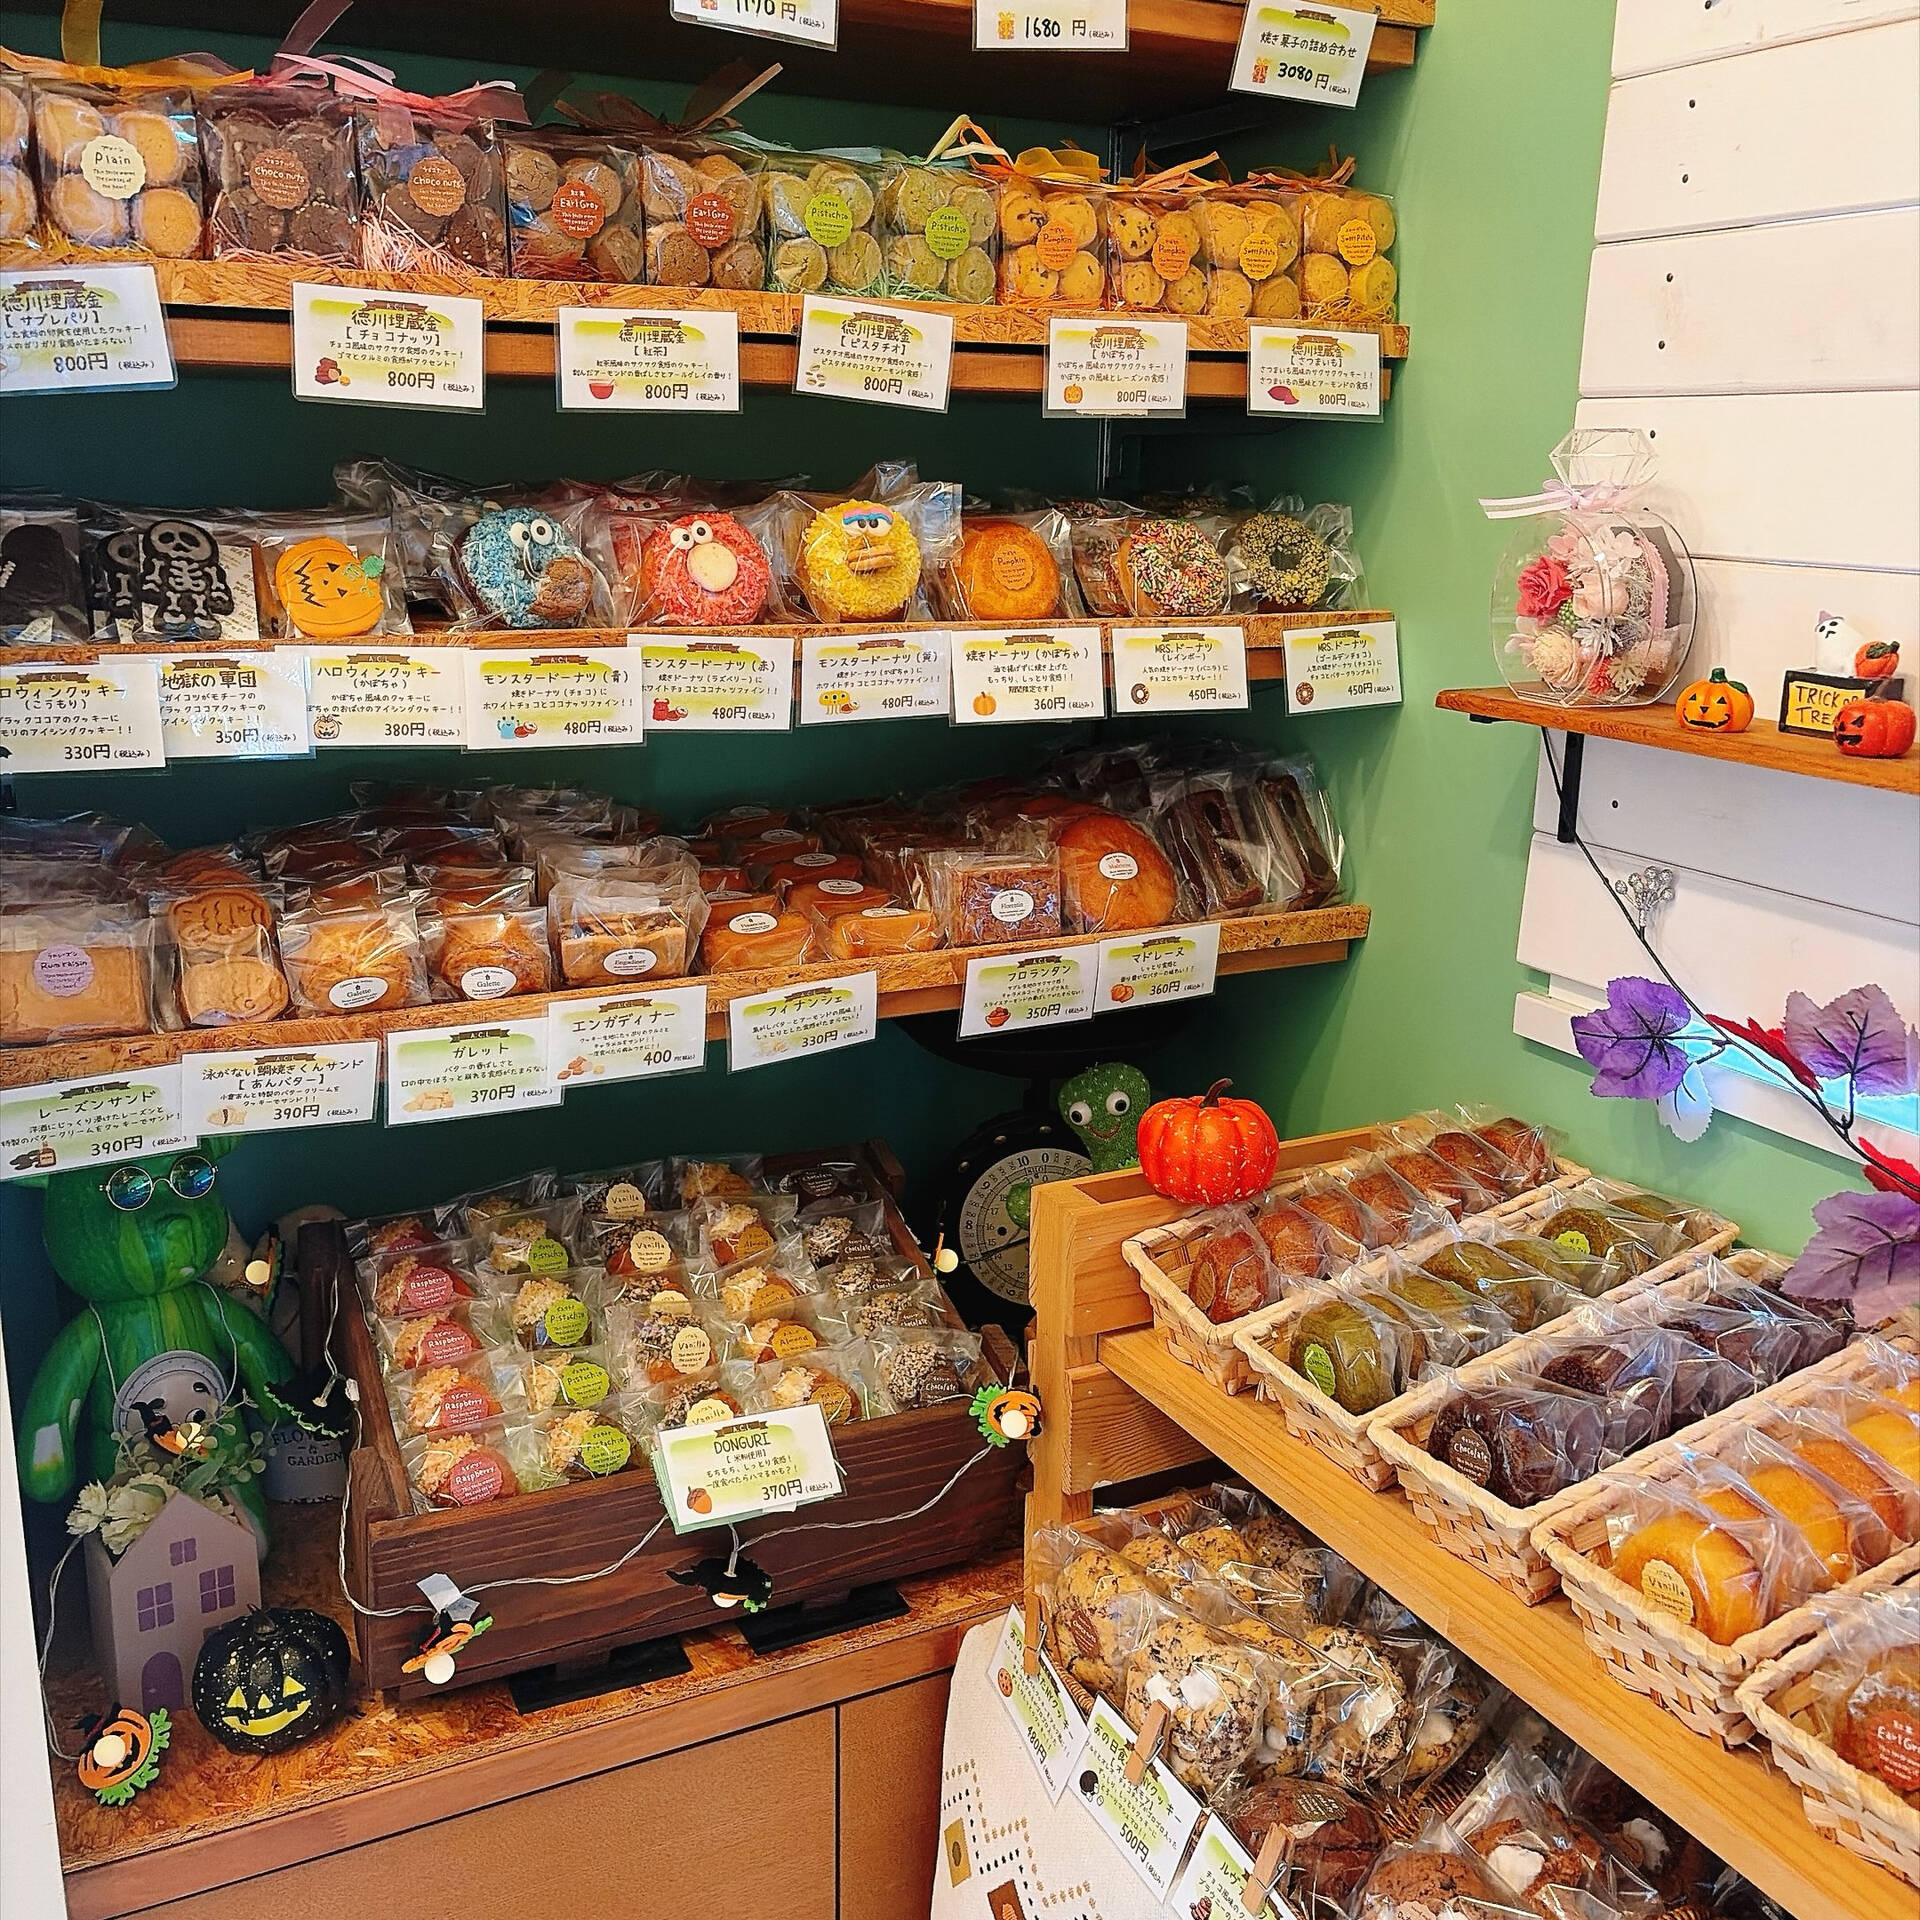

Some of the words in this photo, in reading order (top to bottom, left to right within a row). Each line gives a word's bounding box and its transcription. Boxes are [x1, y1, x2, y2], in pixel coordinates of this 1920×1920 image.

[1025, 15, 1061, 39] 1680
[1260, 32, 1357, 58] 焼き菓子の詰め合わせ
[1278, 63, 1313, 82] 3080
[96, 152, 130, 164] Plain
[561, 198, 578, 207] Earl
[580, 200, 598, 210] Grey
[693, 208, 710, 218] Earl
[711, 210, 729, 220] Grey
[351, 310, 442, 332] 徳川埋蔵金
[619, 329, 687, 344] 徳川埋蔵金
[841, 320, 913, 343] 徳川埋蔵金
[1090, 337, 1147, 350] 徳川埋蔵金
[1292, 344, 1344, 357] 徳川埋蔵金
[53, 353, 108, 373] 800円
[388, 371, 435, 389] 800円
[864, 376, 902, 394] 800円
[645, 384, 688, 399] 800円
[1117, 390, 1146, 402] 800円
[1319, 393, 1346, 405] 800円
[317, 666, 441, 678] ハロウィンクッキー
[162, 671, 257, 690] 地獄の軍団
[1189, 688, 1217, 700] 450円
[1348, 683, 1372, 696] 450円
[1795, 685, 1840, 707] TRICK
[882, 695, 912, 709] 480円
[1034, 697, 1066, 710] 360円
[712, 707, 746, 720] 480円
[385, 722, 425, 736] 380円
[564, 721, 600, 734] 480円
[65, 744, 110, 759] 330円
[1132, 947, 1184, 963] マドレーヌ
[1008, 966, 1071, 982] フロランタン
[347, 989, 371, 998] Galette
[1150, 981, 1180, 995] 360円
[767, 995, 842, 1016] フィナンシェ
[1027, 1004, 1060, 1019] 350円
[573, 1011, 675, 1032] エンガディナー
[802, 1030, 838, 1048] 330円
[453, 1043, 509, 1059] ガレット
[644, 1050, 672, 1066] 400
[202, 1060, 364, 1080] 泳がない鯛焼きくんサンド
[471, 1085, 515, 1103] 370円
[39, 1090, 156, 1119] レーズンサンド
[274, 1105, 319, 1120] 390円
[91, 1135, 143, 1156] 390円
[612, 1195, 639, 1203] Vanilla
[411, 1276, 447, 1289] Raspberry
[428, 1335, 466, 1348] Raspberry
[678, 1340, 706, 1350] Vanilla
[926, 1383, 956, 1392] Chocolate
[445, 1398, 482, 1410] Raspberry
[714, 1432, 771, 1454] DONGURI
[288, 1452, 343, 1466] GARDEN
[1454, 1443, 1488, 1463] Chocolate
[456, 1466, 495, 1484] Raspberry
[762, 1479, 802, 1500] 370円
[1649, 1576, 1685, 1597] Vanilla
[1878, 1726, 1902, 1745] Earl
[1027, 1726, 1046, 1763] 480円
[1120, 1823, 1149, 1862] 500円
